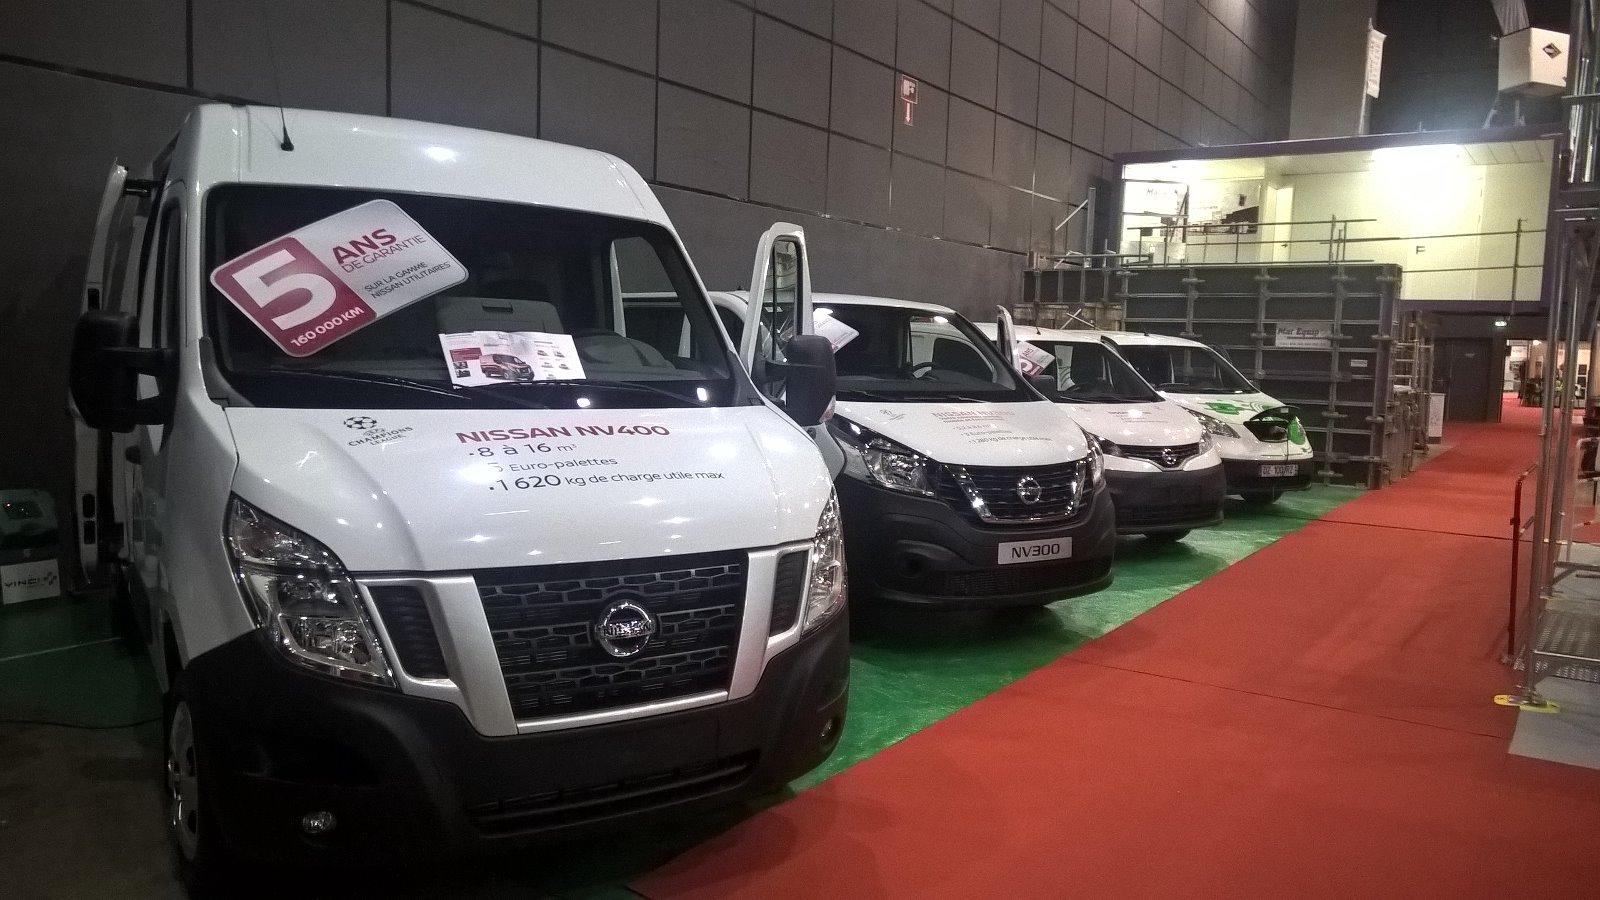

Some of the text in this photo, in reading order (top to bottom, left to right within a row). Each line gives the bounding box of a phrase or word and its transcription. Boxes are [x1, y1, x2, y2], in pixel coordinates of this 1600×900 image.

[333, 228, 397, 265] ANS
[341, 234, 427, 274] DE GARANTIE
[364, 261, 428, 292] SUR LA GAMME
[370, 261, 452, 299] NISSAN UTILITAIRES
[232, 249, 337, 331] 5
[290, 330, 317, 347] 160
[456, 425, 670, 443] NISSAN NV400
[502, 444, 519, 455] à
[523, 442, 552, 454] 16
[508, 456, 618, 472] Euro-palettes
[514, 474, 561, 490] 620
[564, 476, 587, 487] kg
[588, 474, 609, 484] de
[610, 472, 662, 483] charge
[663, 471, 694, 480] utile
[695, 471, 725, 480] max
[1011, 543, 1060, 559] NV300
